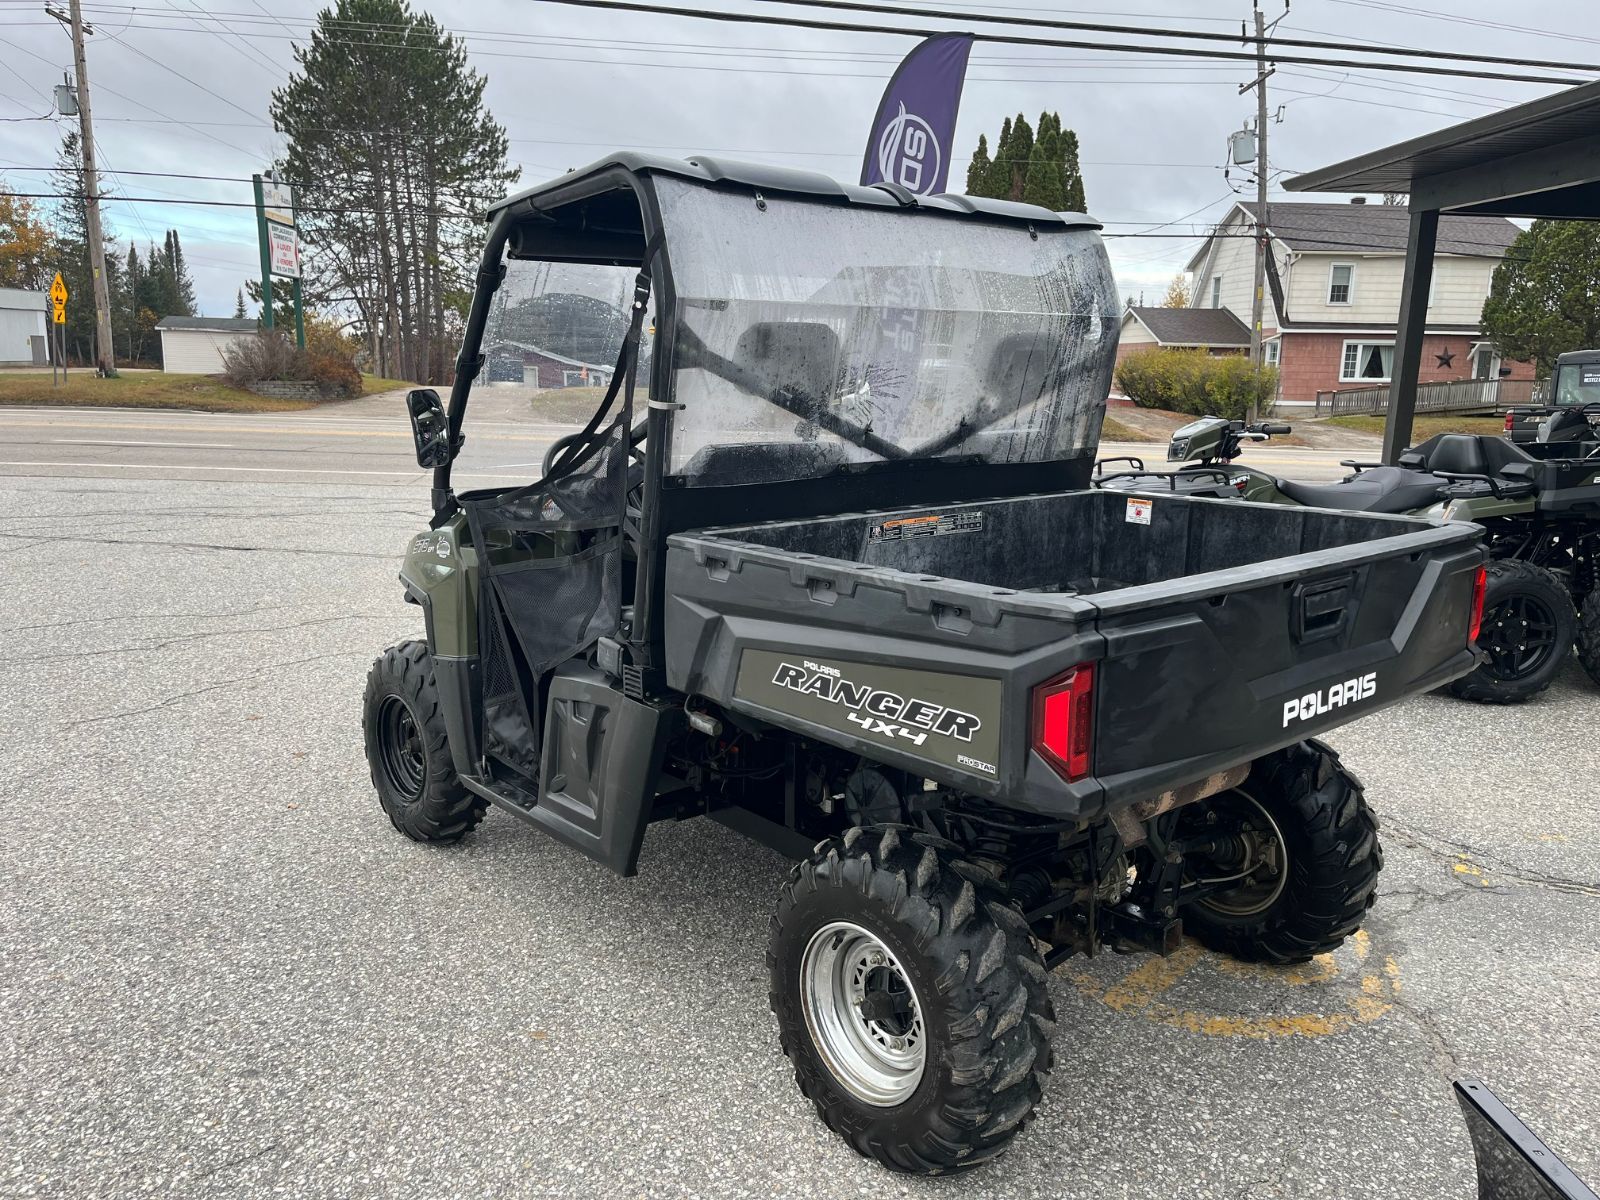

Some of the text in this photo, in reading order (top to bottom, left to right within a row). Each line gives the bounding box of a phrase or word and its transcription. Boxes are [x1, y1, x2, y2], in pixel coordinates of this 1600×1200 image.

[803, 660, 841, 677] POLARIS
[772, 663, 982, 742] RANGER
[1282, 671, 1377, 728] POLARIS
[957, 754, 996, 774] PROSTAR
